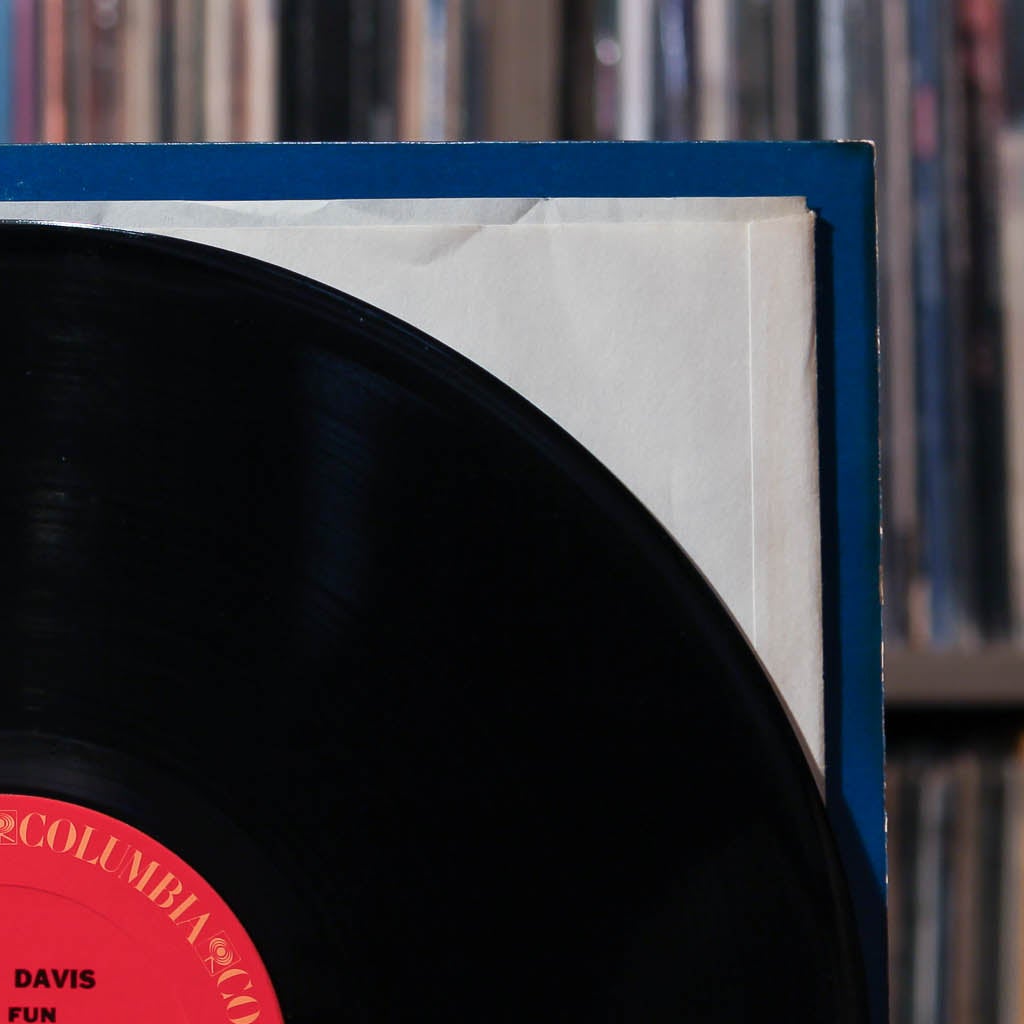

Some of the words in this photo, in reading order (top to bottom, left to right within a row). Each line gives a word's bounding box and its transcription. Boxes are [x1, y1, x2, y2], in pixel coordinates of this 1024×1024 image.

[19, 811, 210, 944] COLUMBIA
[14, 968, 96, 989] DAVIS
[8, 1006, 56, 1023] FUN
